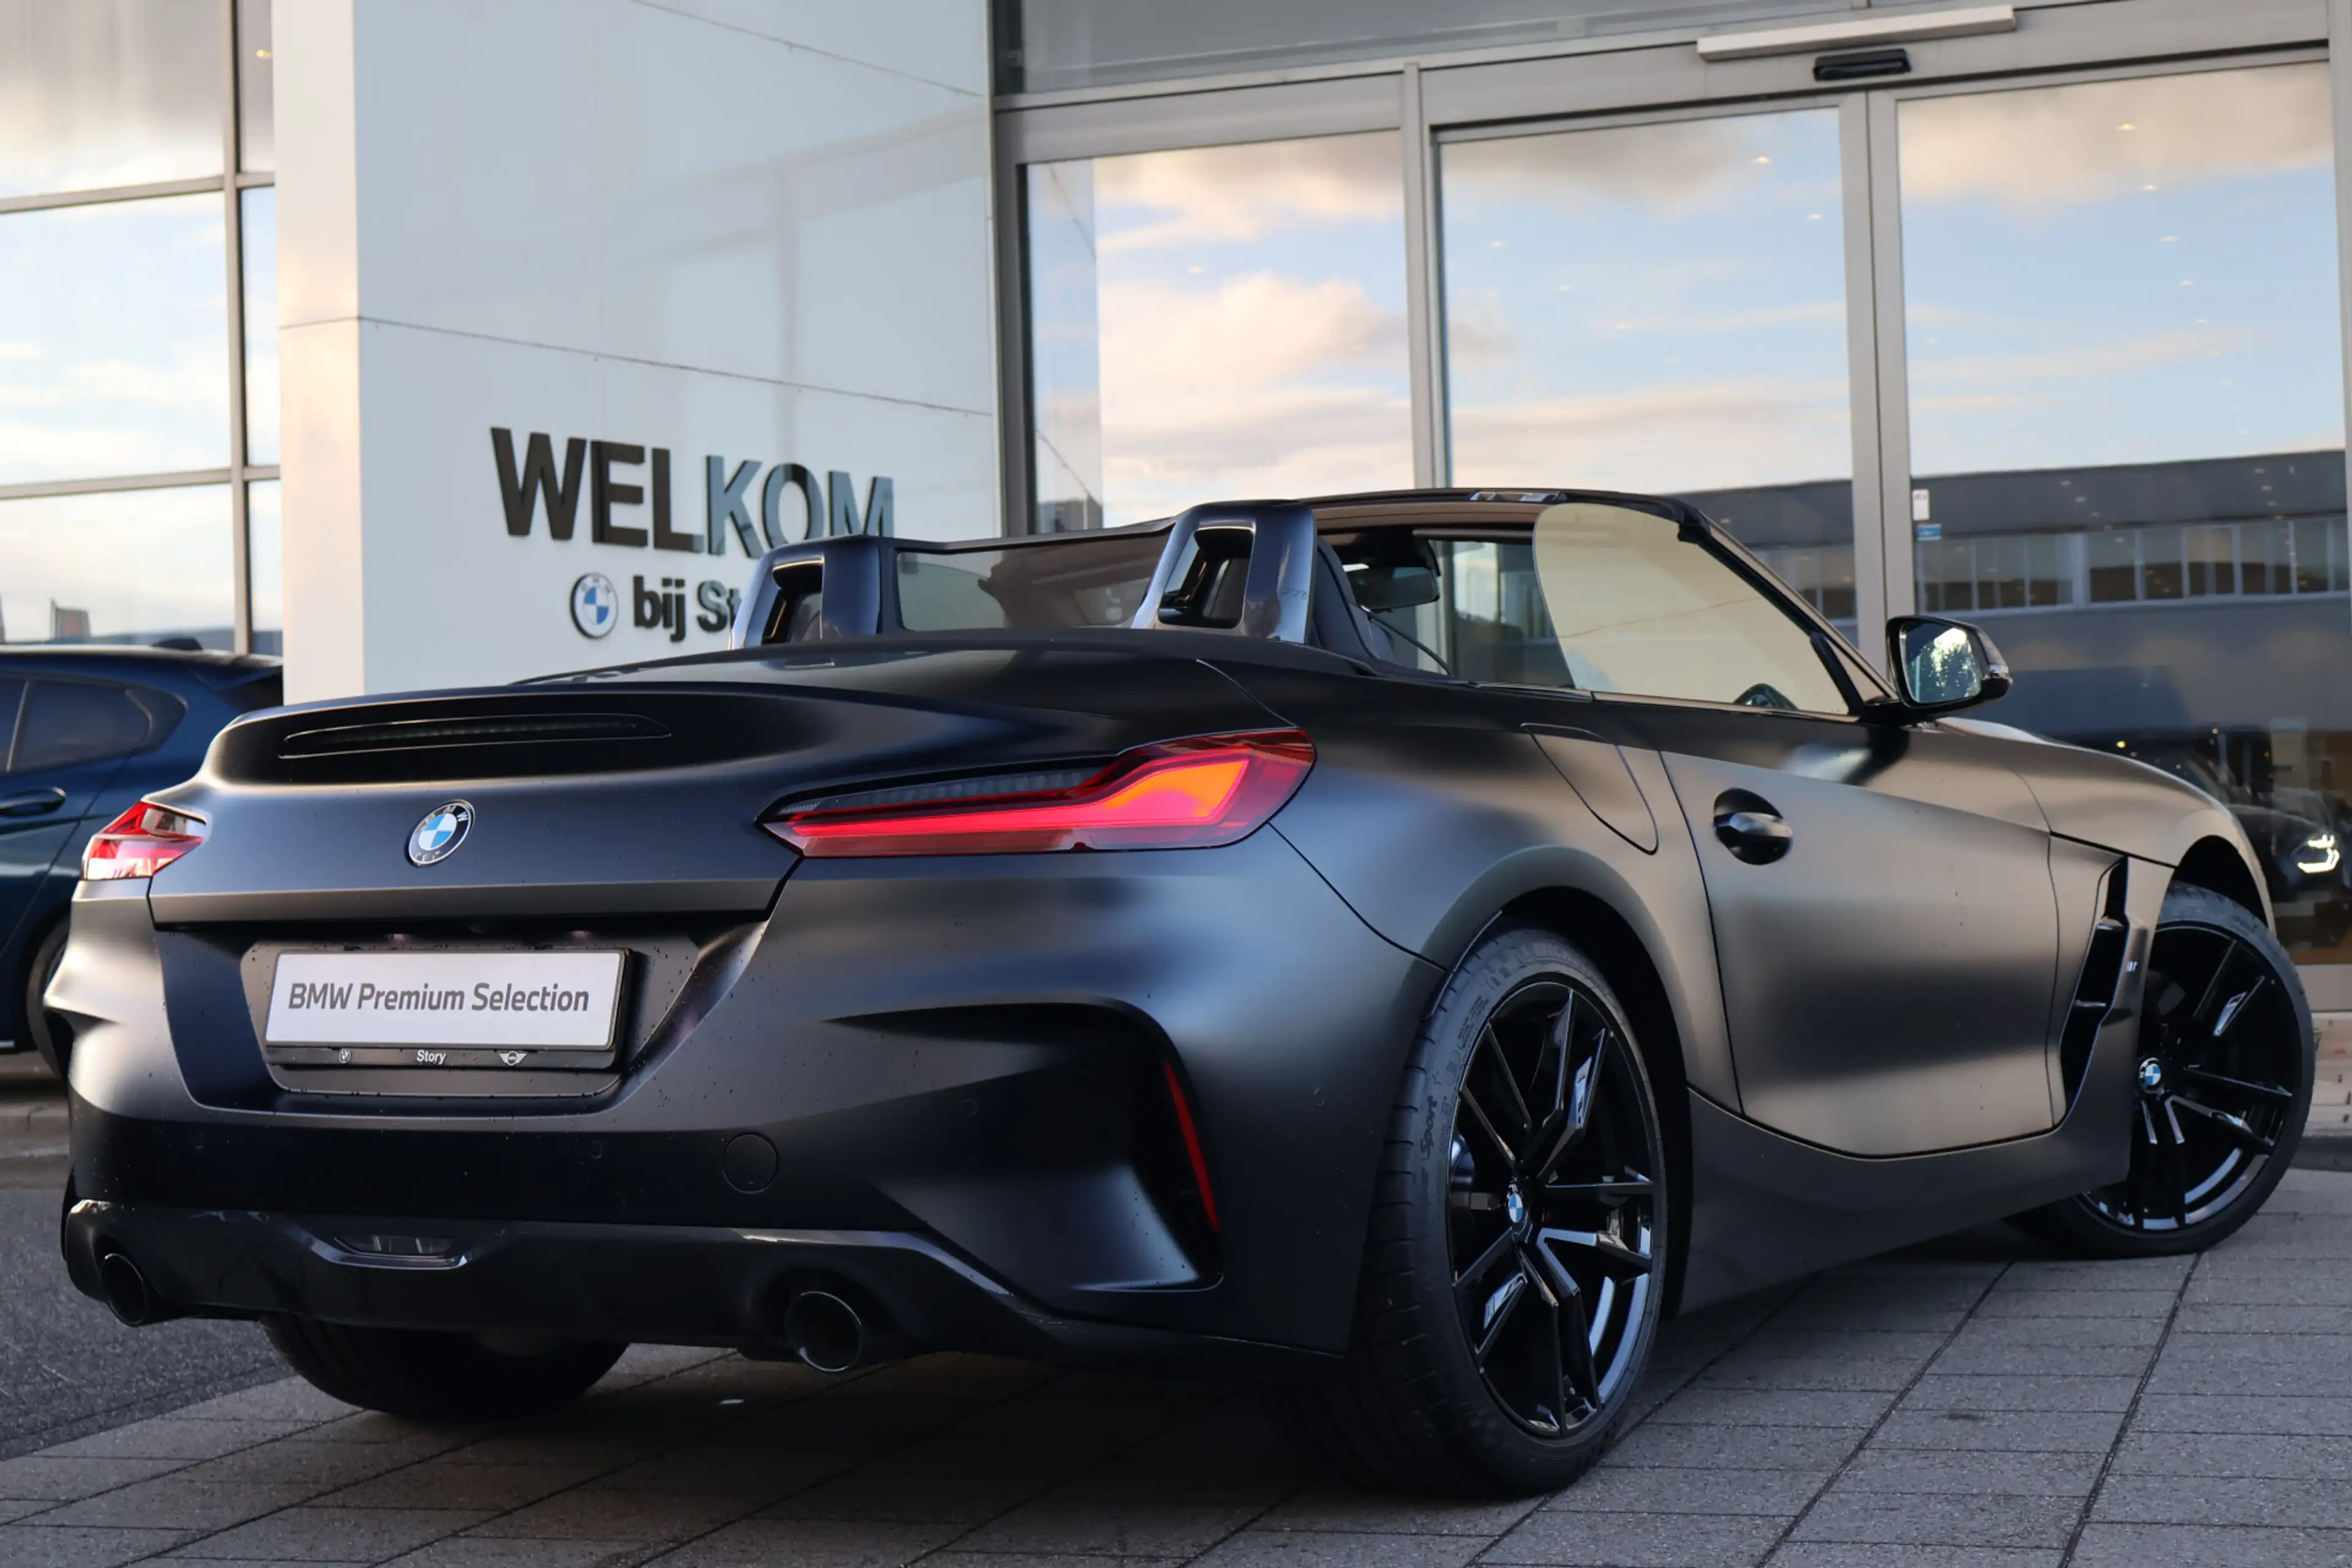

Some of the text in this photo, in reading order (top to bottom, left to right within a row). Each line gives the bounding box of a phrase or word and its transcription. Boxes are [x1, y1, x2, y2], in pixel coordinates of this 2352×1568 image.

[491, 427, 894, 558] WELKOM
[633, 575, 686, 643] bij
[288, 982, 589, 1012] BMW Premium Selection
[416, 1049, 447, 1065] Story
